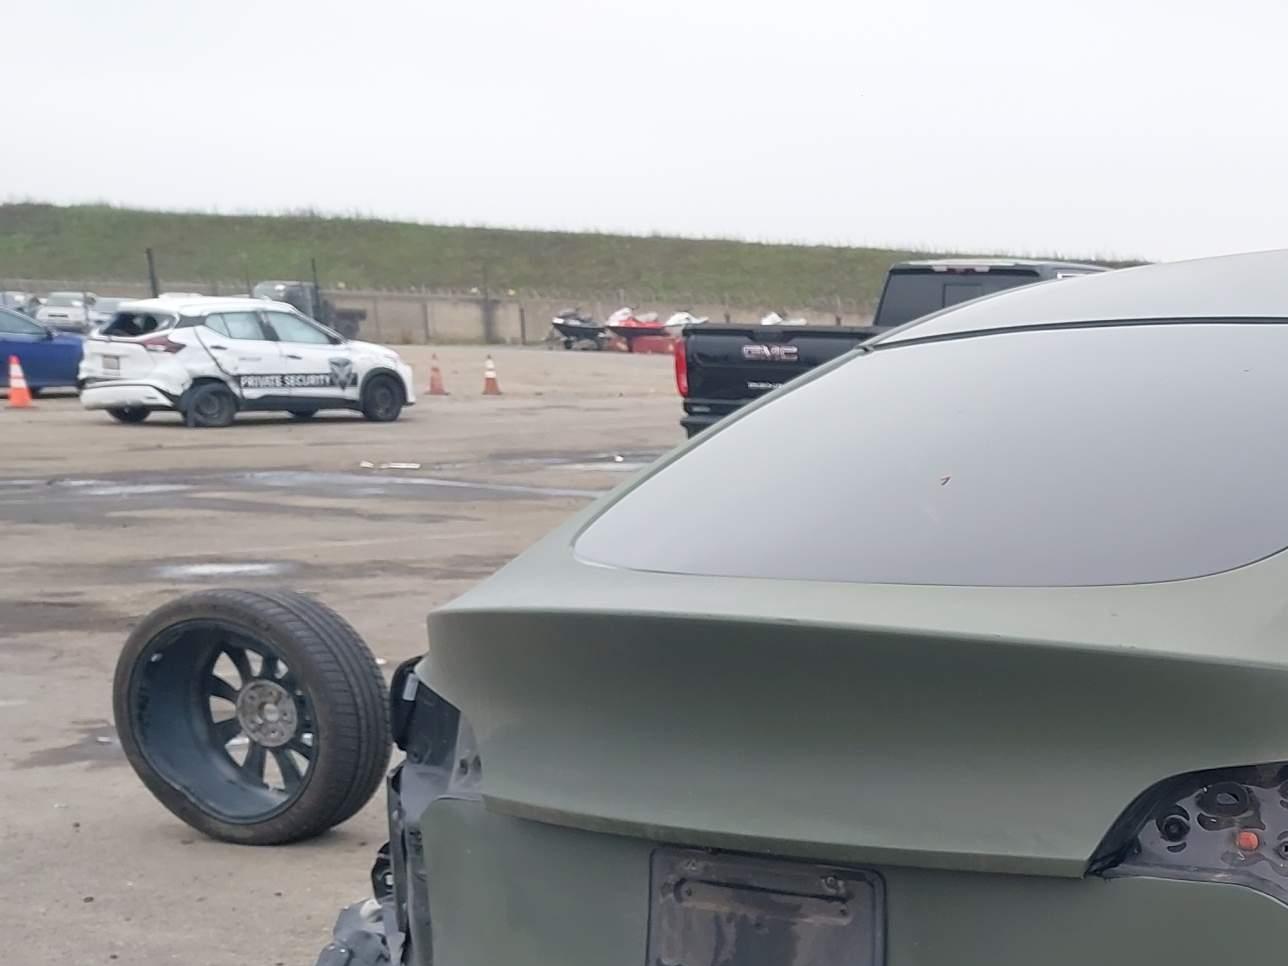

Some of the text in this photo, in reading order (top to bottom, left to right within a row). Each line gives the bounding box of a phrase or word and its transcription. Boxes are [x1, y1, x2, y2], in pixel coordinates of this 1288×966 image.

[743, 345, 798, 360] GMC
[240, 375, 331, 387] PRIVATE SECURITY
